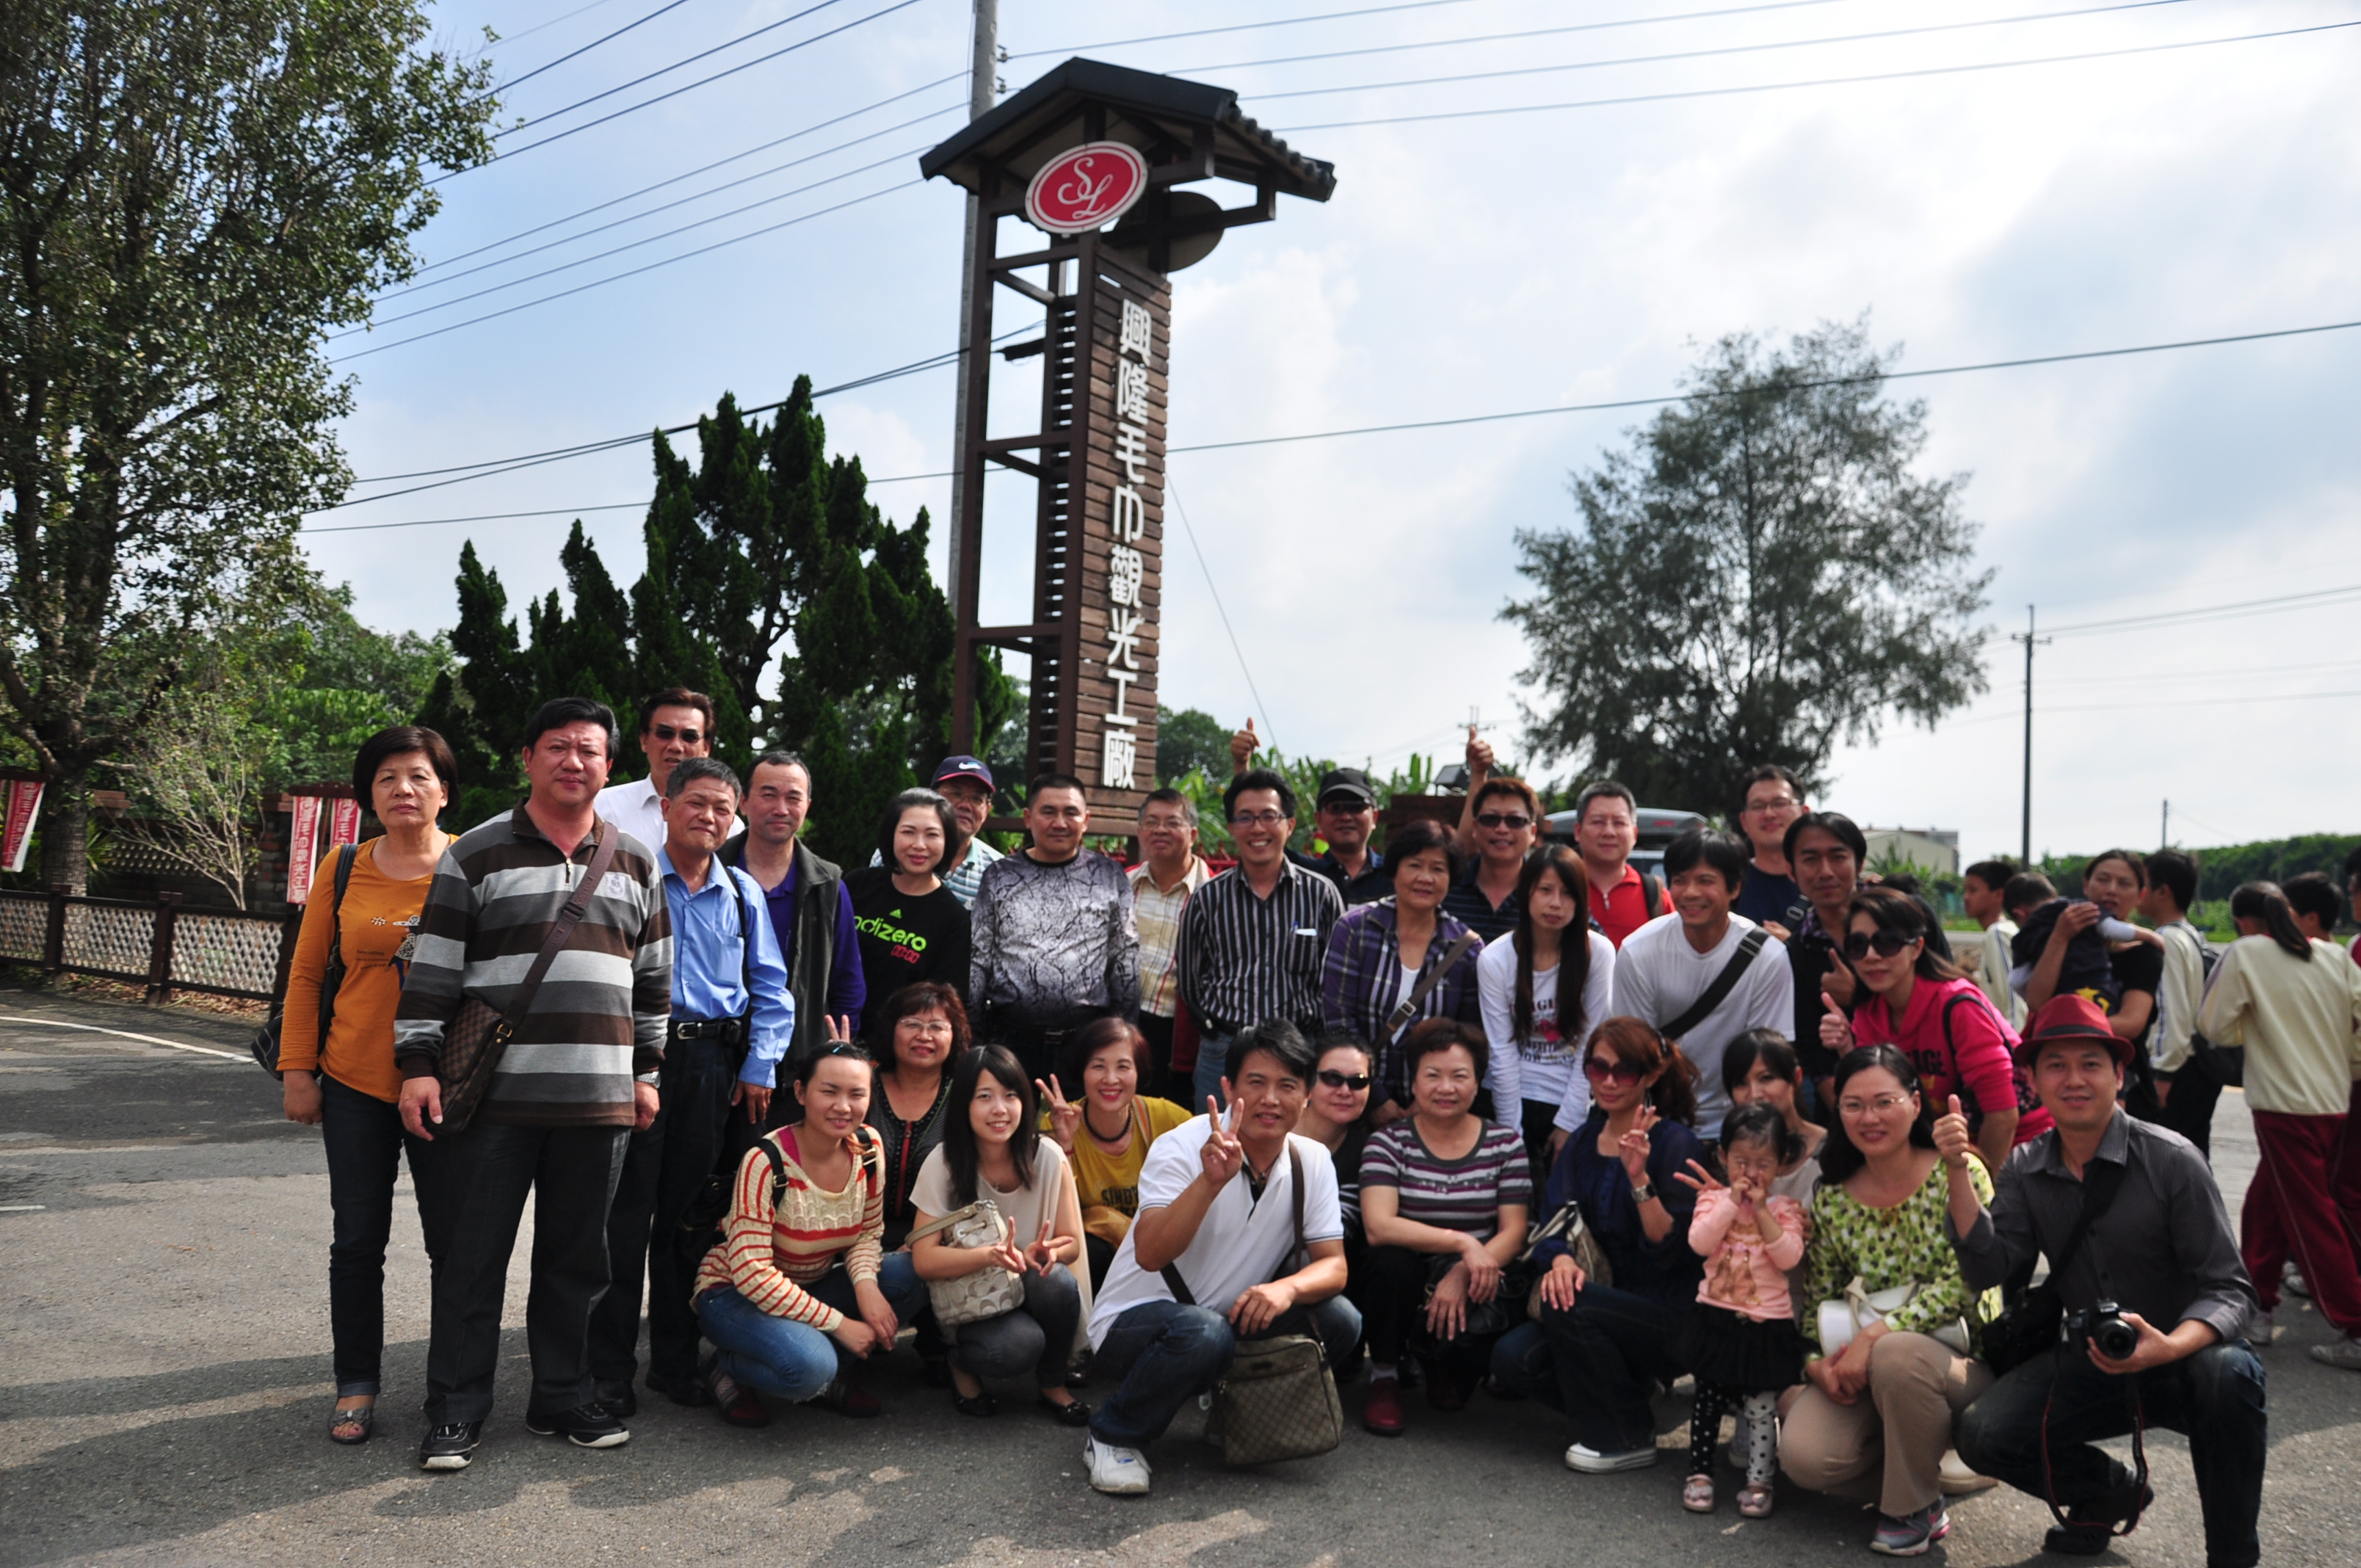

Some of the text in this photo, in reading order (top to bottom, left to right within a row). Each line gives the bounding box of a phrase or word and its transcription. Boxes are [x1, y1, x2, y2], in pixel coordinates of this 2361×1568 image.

[1103, 298, 1152, 790] 興隆毛巾觀光工廠
